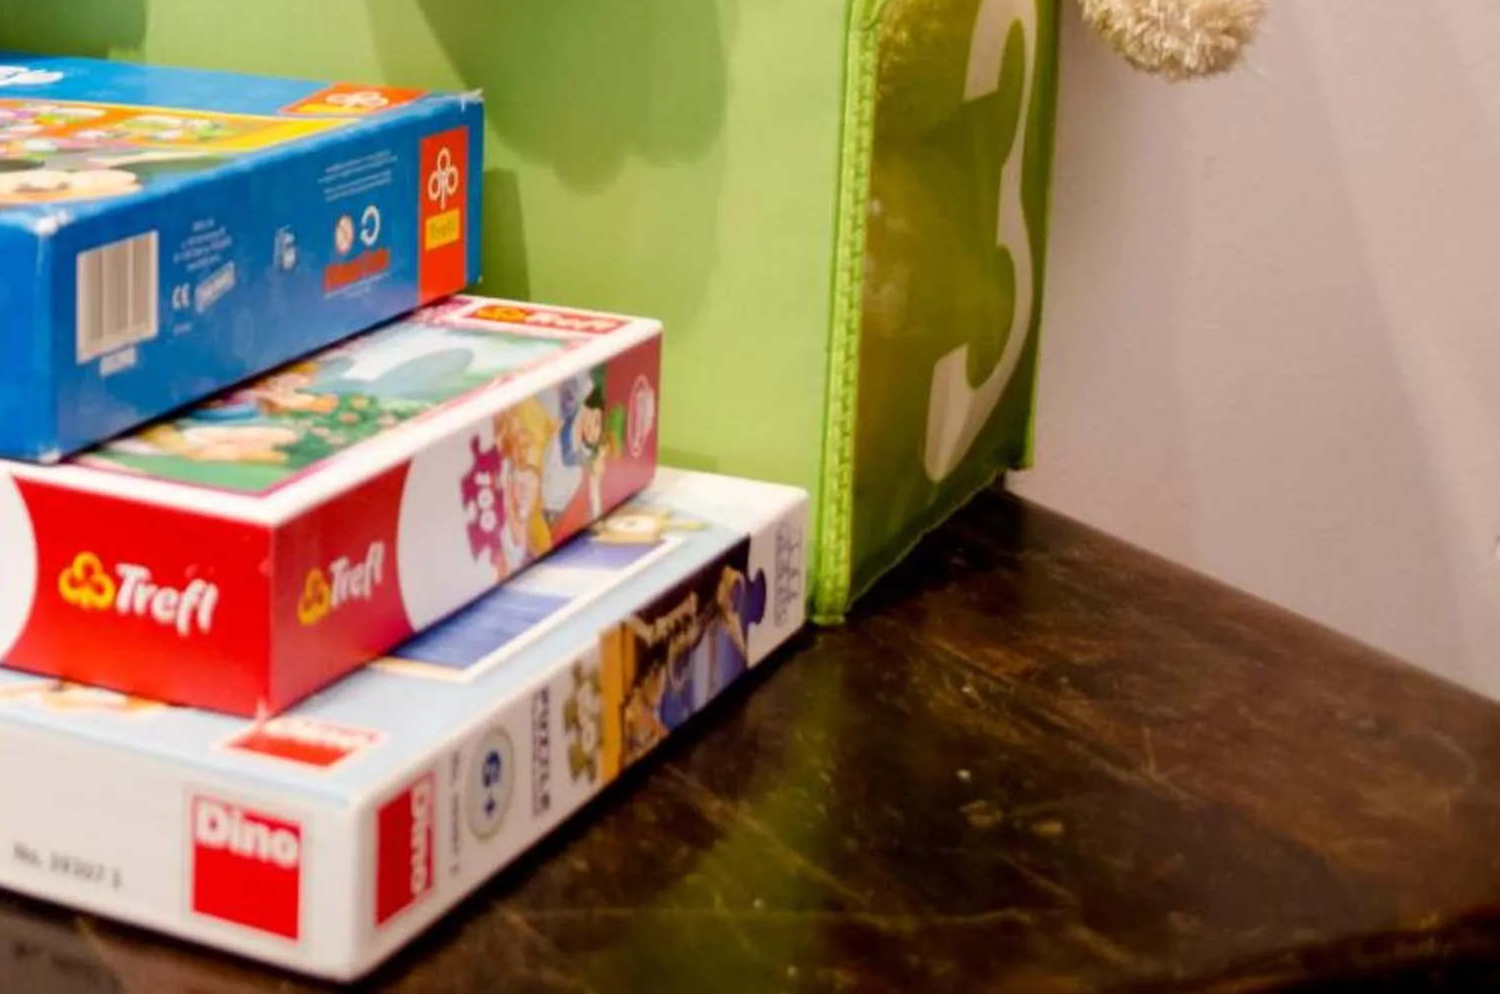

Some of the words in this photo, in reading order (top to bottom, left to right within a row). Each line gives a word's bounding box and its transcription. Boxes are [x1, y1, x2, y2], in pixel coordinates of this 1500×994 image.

[115, 562, 219, 638] Trefl
[329, 541, 385, 609] Trefl
[198, 804, 299, 868] Dino
